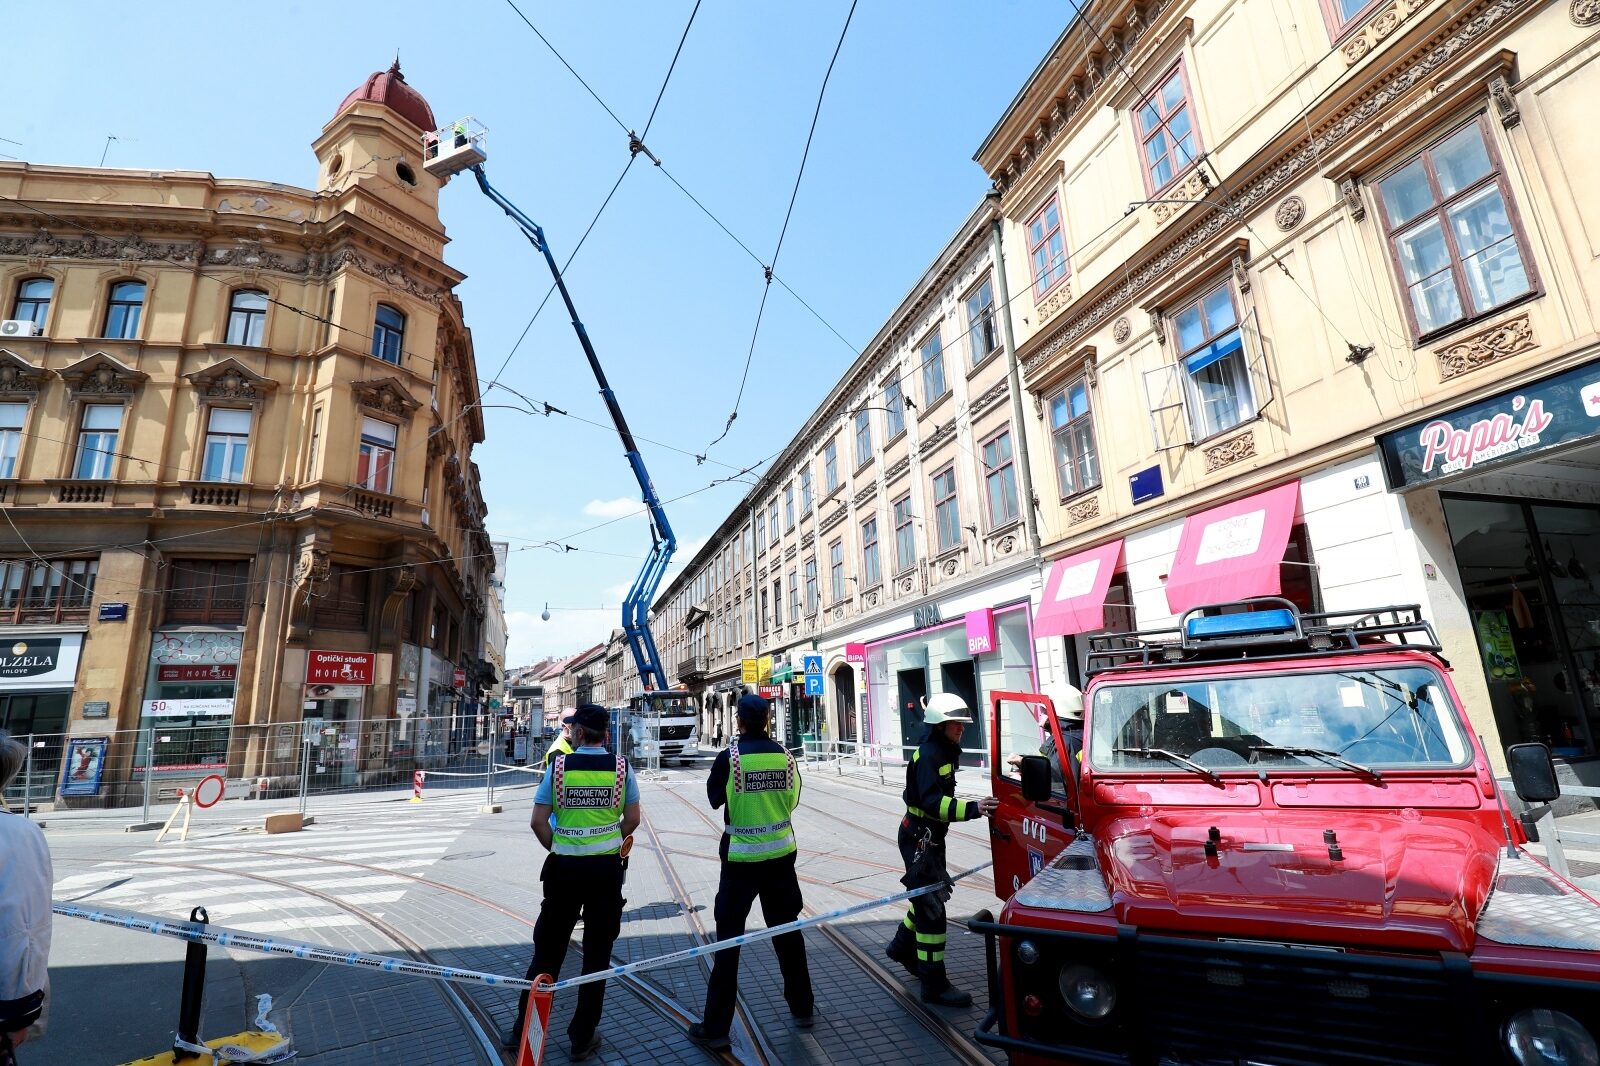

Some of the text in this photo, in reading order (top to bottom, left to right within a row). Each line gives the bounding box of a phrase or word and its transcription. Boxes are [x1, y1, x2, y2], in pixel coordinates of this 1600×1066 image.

[1420, 395, 1553, 473] Papa's
[1475, 443, 1518, 462] AMERICAN
[1520, 435, 1538, 447] BAR
[913, 600, 944, 629] BIPA
[968, 635, 990, 652] BIPA
[0, 655, 53, 668] LZELA
[317, 654, 367, 664] Optički studio
[810, 678, 818, 692] P
[747, 771, 785, 781] PROMETNO
[746, 780, 786, 790] REDARSTVO
[568, 789, 609, 797] PROMETNO
[566, 797, 610, 806] REDARSTVO
[734, 826, 767, 834] PROMETNO
